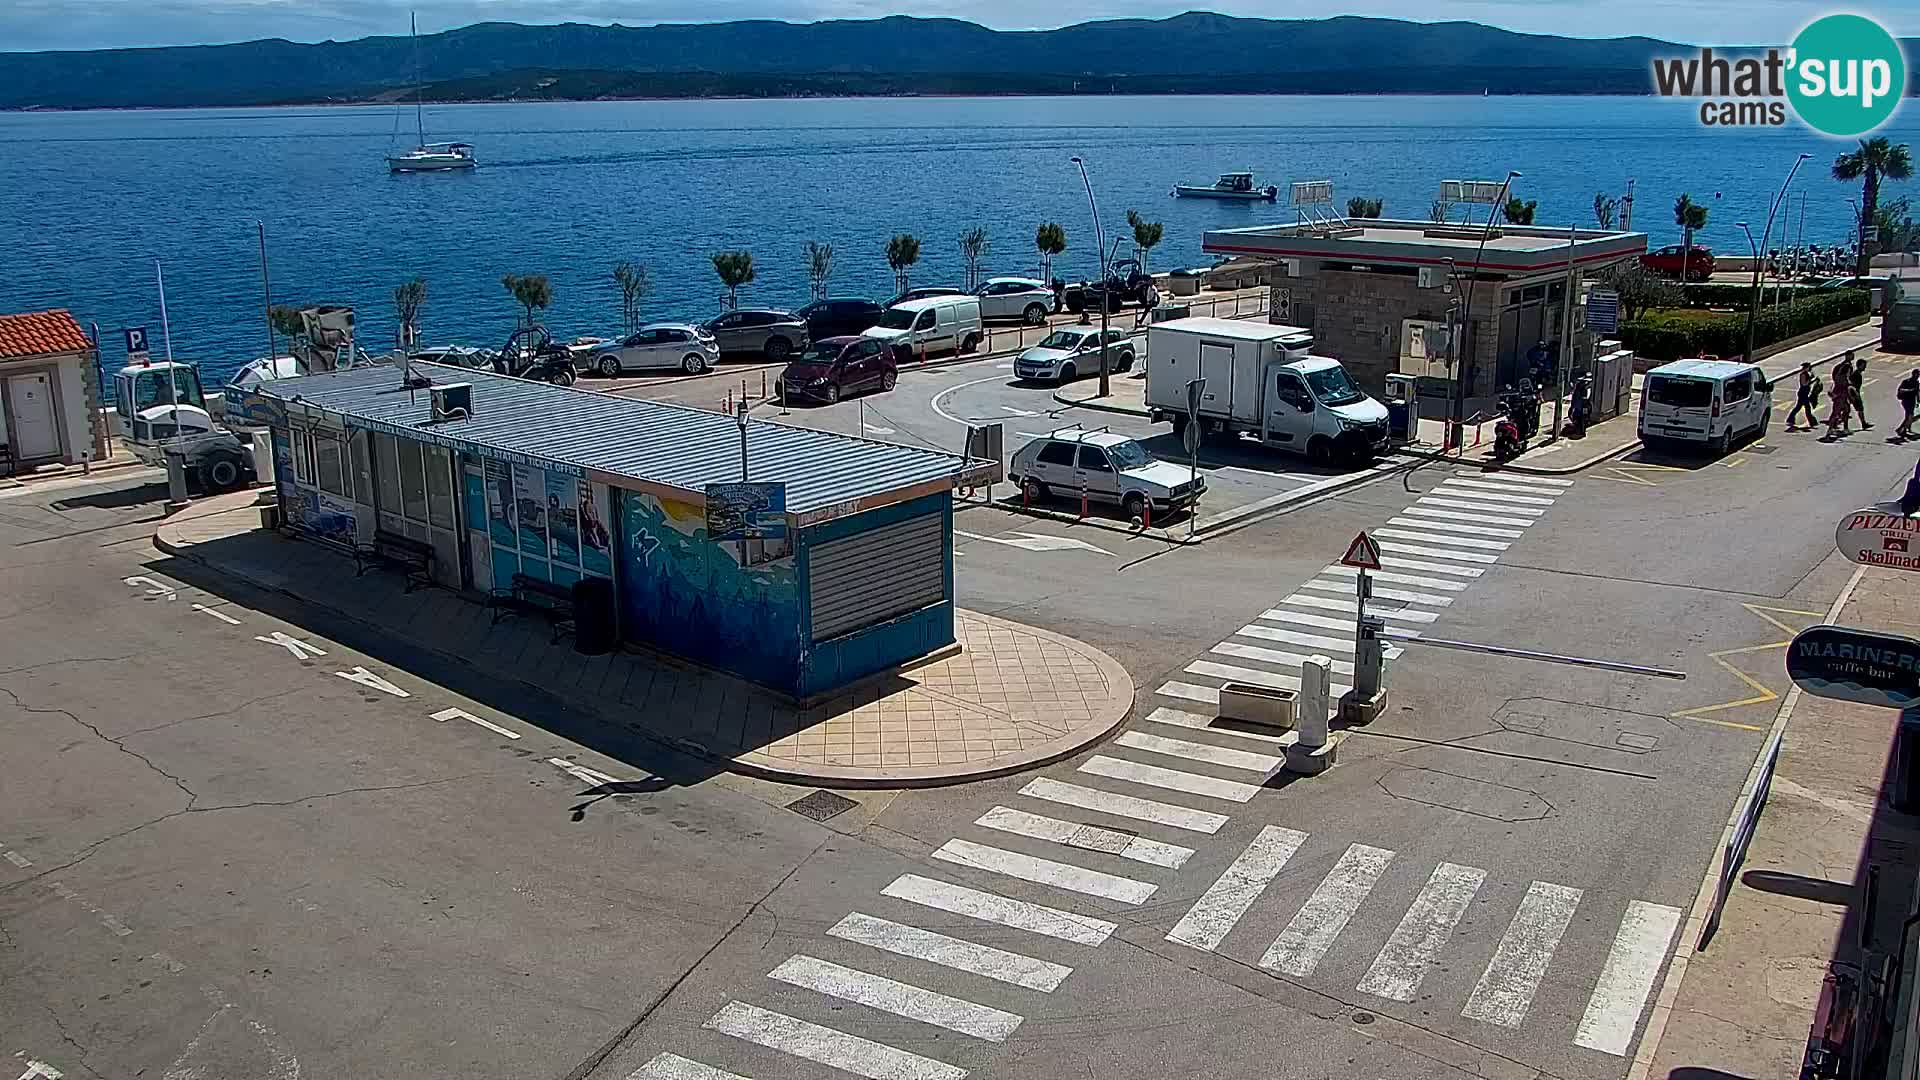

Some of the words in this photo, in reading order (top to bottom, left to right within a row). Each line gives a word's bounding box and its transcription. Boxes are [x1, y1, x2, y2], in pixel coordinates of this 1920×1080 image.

[129, 331, 142, 349] P
[436, 436, 466, 450] POSTAJA
[477, 445, 492, 457] BUS
[494, 448, 525, 464] STATION
[527, 456, 552, 470] TICKET
[554, 462, 581, 477] OFFICE
[1869, 665, 1895, 679] bar
